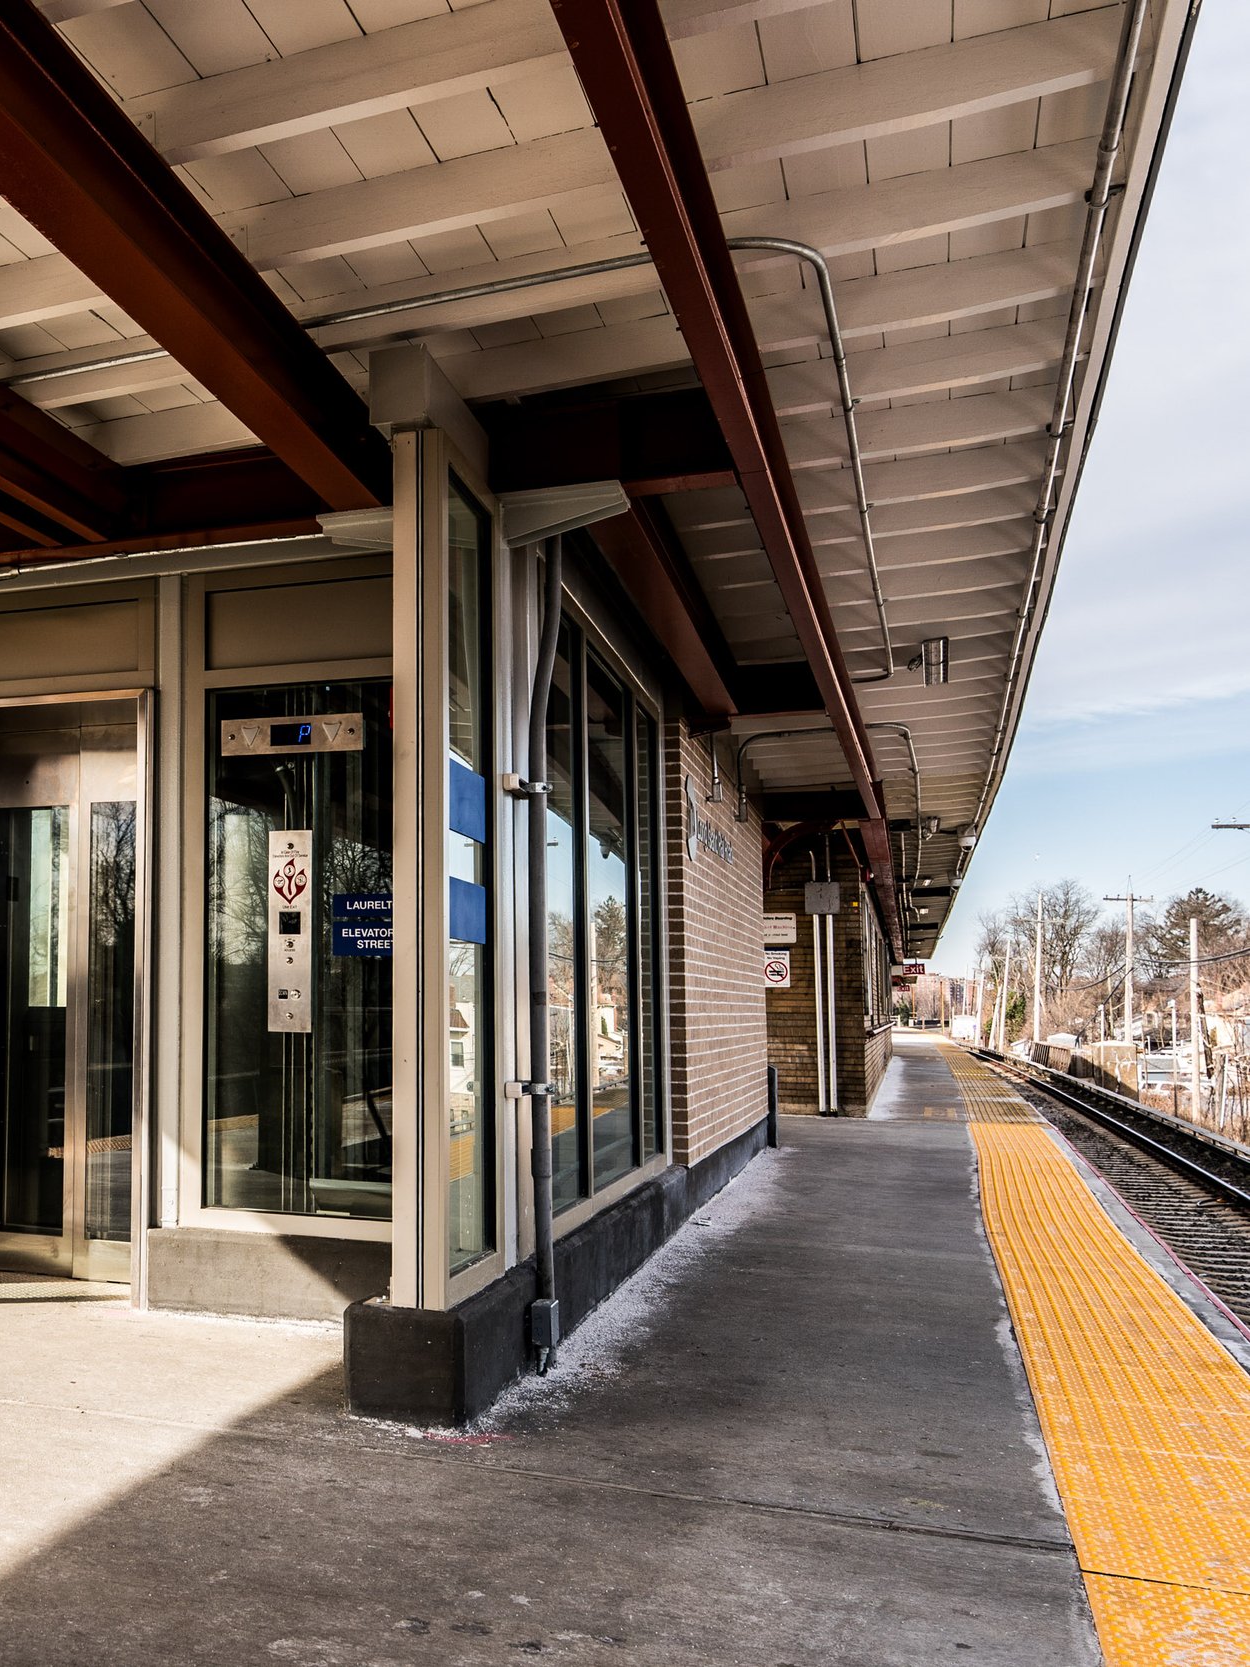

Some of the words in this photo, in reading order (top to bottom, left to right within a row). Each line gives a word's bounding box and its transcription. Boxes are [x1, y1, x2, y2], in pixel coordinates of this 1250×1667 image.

[298, 725, 311, 742] P
[346, 901, 393, 910] LAURELT
[342, 928, 393, 938] ELEVATOR
[903, 965, 924, 974] Exit
